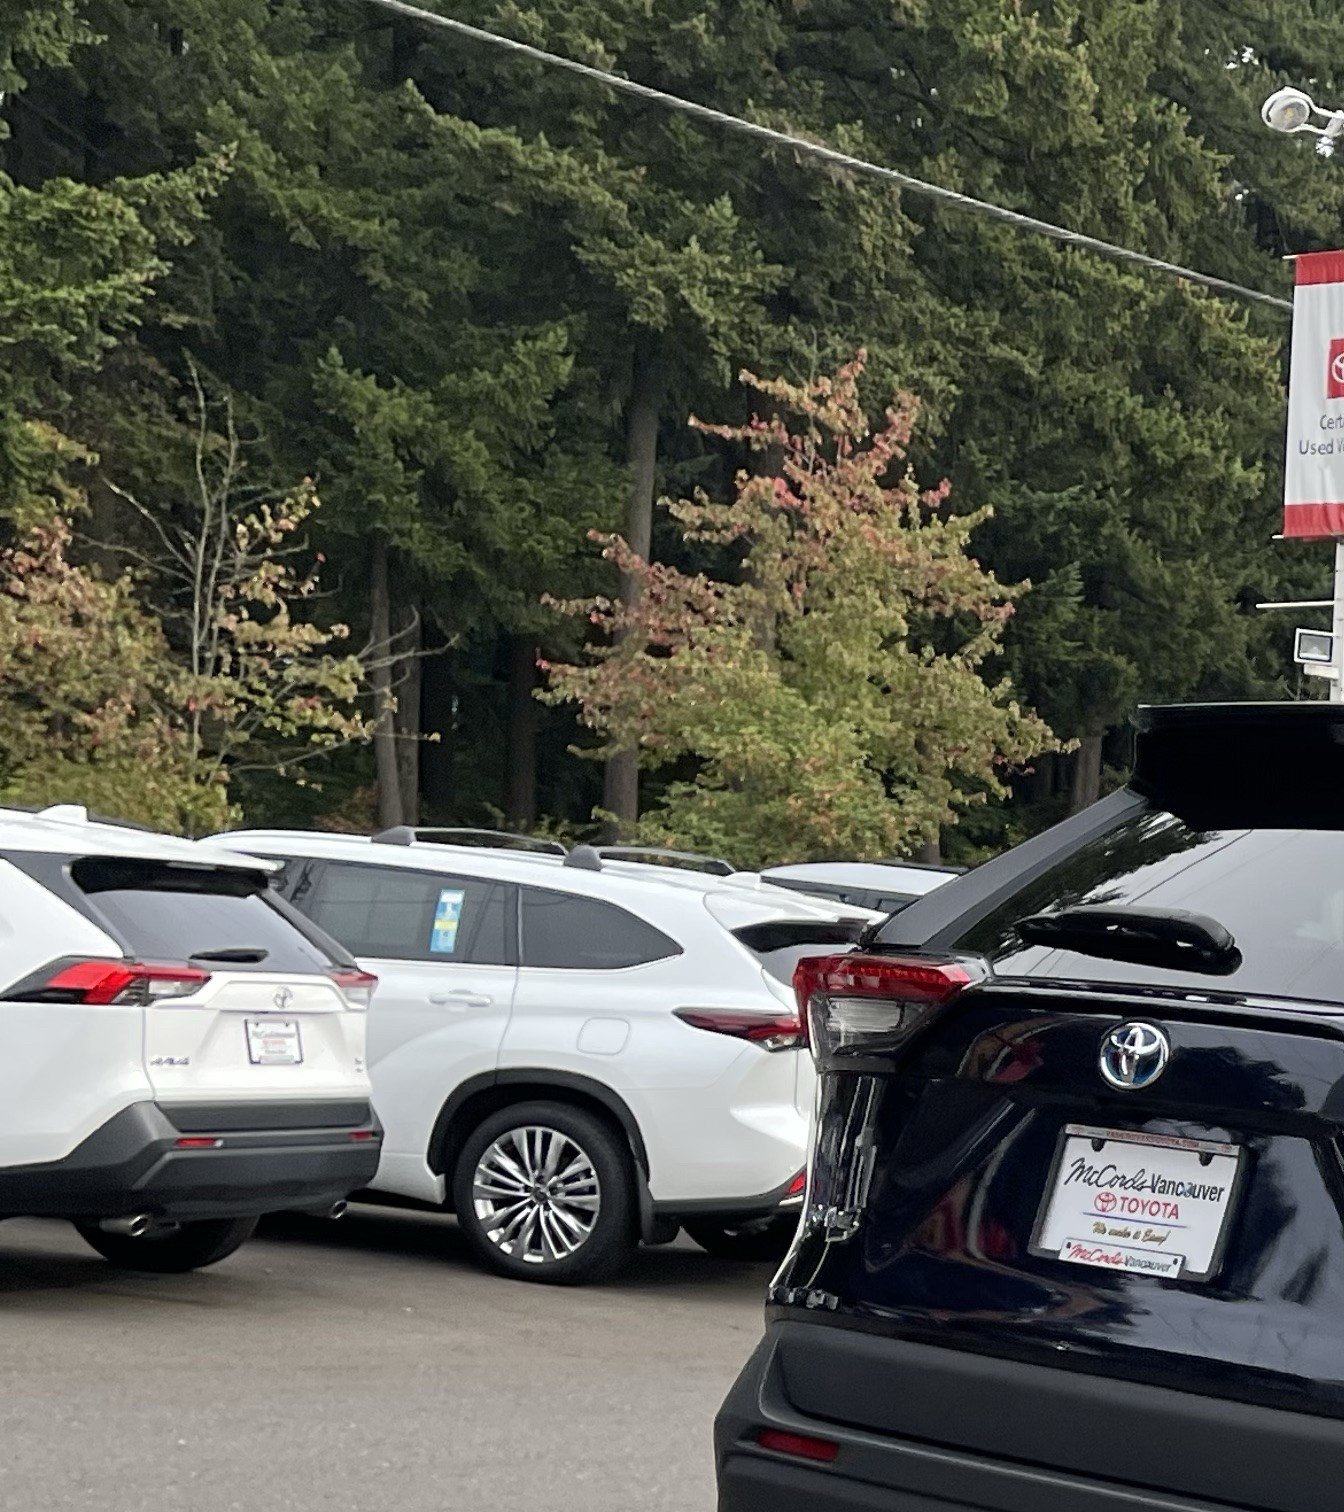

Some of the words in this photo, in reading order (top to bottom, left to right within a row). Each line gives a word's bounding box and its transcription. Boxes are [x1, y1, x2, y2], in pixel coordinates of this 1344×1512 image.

[1299, 440, 1335, 456] Used
[1150, 1173, 1225, 1202] Vancouver
[1119, 1196, 1180, 1220] TOYOTA
